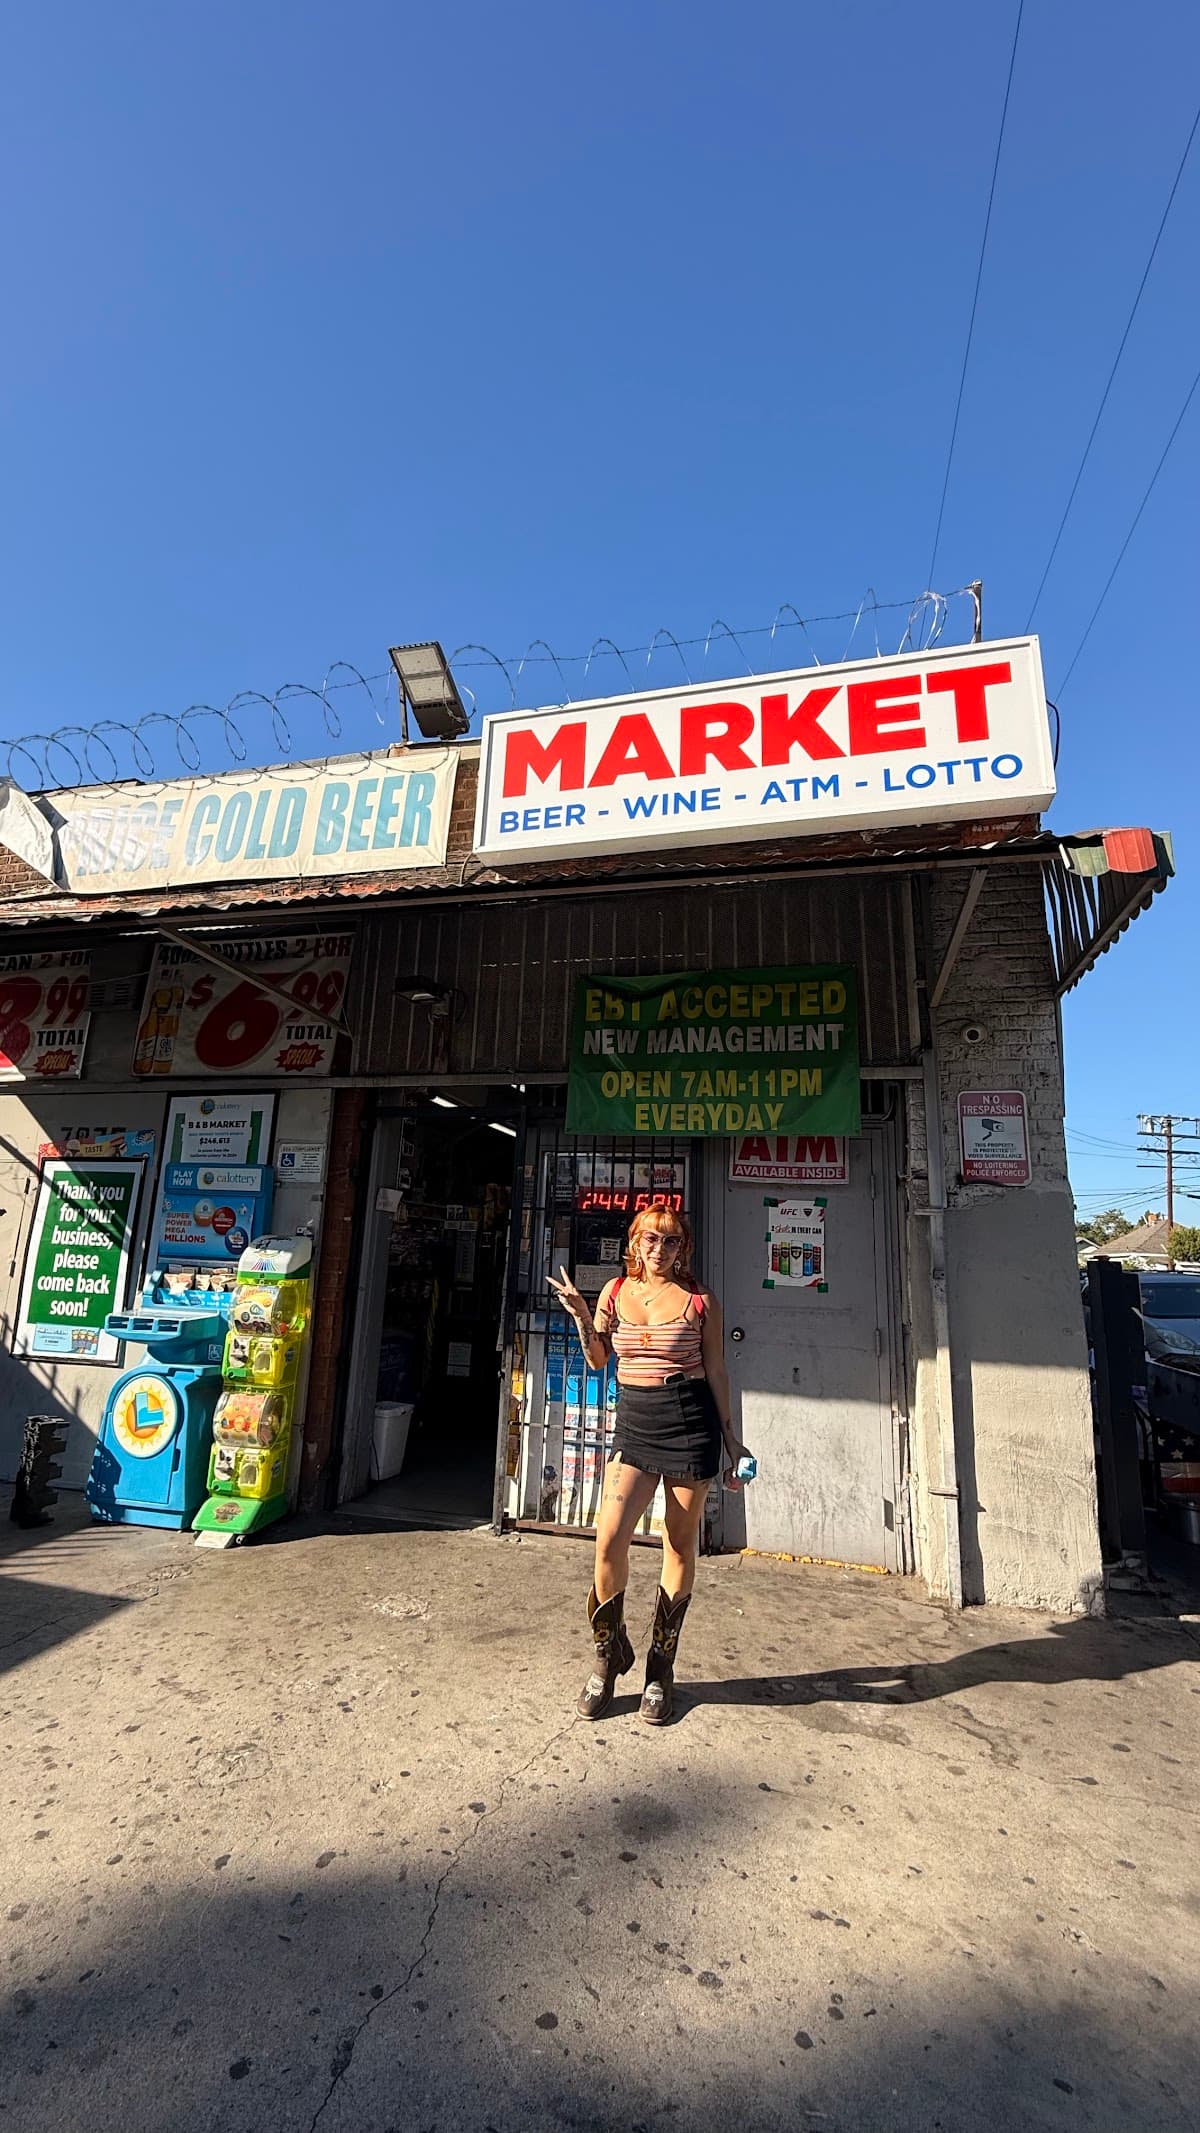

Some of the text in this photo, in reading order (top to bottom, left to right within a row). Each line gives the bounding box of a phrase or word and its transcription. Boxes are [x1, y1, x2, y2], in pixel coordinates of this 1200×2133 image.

[502, 661, 1012, 798] MARKET
[500, 804, 585, 834] BEER
[623, 788, 721, 818] WINE
[760, 774, 839, 806] ATM
[883, 754, 1023, 791] LOTTO
[186, 787, 307, 866] COLD
[312, 773, 436, 856] BEER
[314, 936, 352, 958] FOR
[657, 980, 847, 1021] ACCEPTED
[37, 1030, 84, 1046] TOTAL
[287, 1025, 332, 1041] TOTAL
[583, 1022, 844, 1055] NEW MANAGEMENT
[601, 1069, 822, 1098] OPEN 7AM-11PM
[962, 1105, 1022, 1114] TRESPASSING
[982, 1095, 1000, 1104] NO
[635, 1103, 784, 1131] EVERYDAY
[173, 1178, 193, 1187] NOW
[216, 1172, 257, 1186] calottery
[735, 1165, 843, 1179] AVAILABLE INSIDE
[57, 1180, 125, 1204] Thank you
[59, 1203, 115, 1228] for your
[780, 1208, 798, 1216] UFC
[51, 1224, 114, 1249] business,
[164, 1234, 206, 1243] MILLIONS
[53, 1249, 99, 1273] please
[38, 1273, 111, 1294] come back
[49, 1298, 89, 1317] soon!
